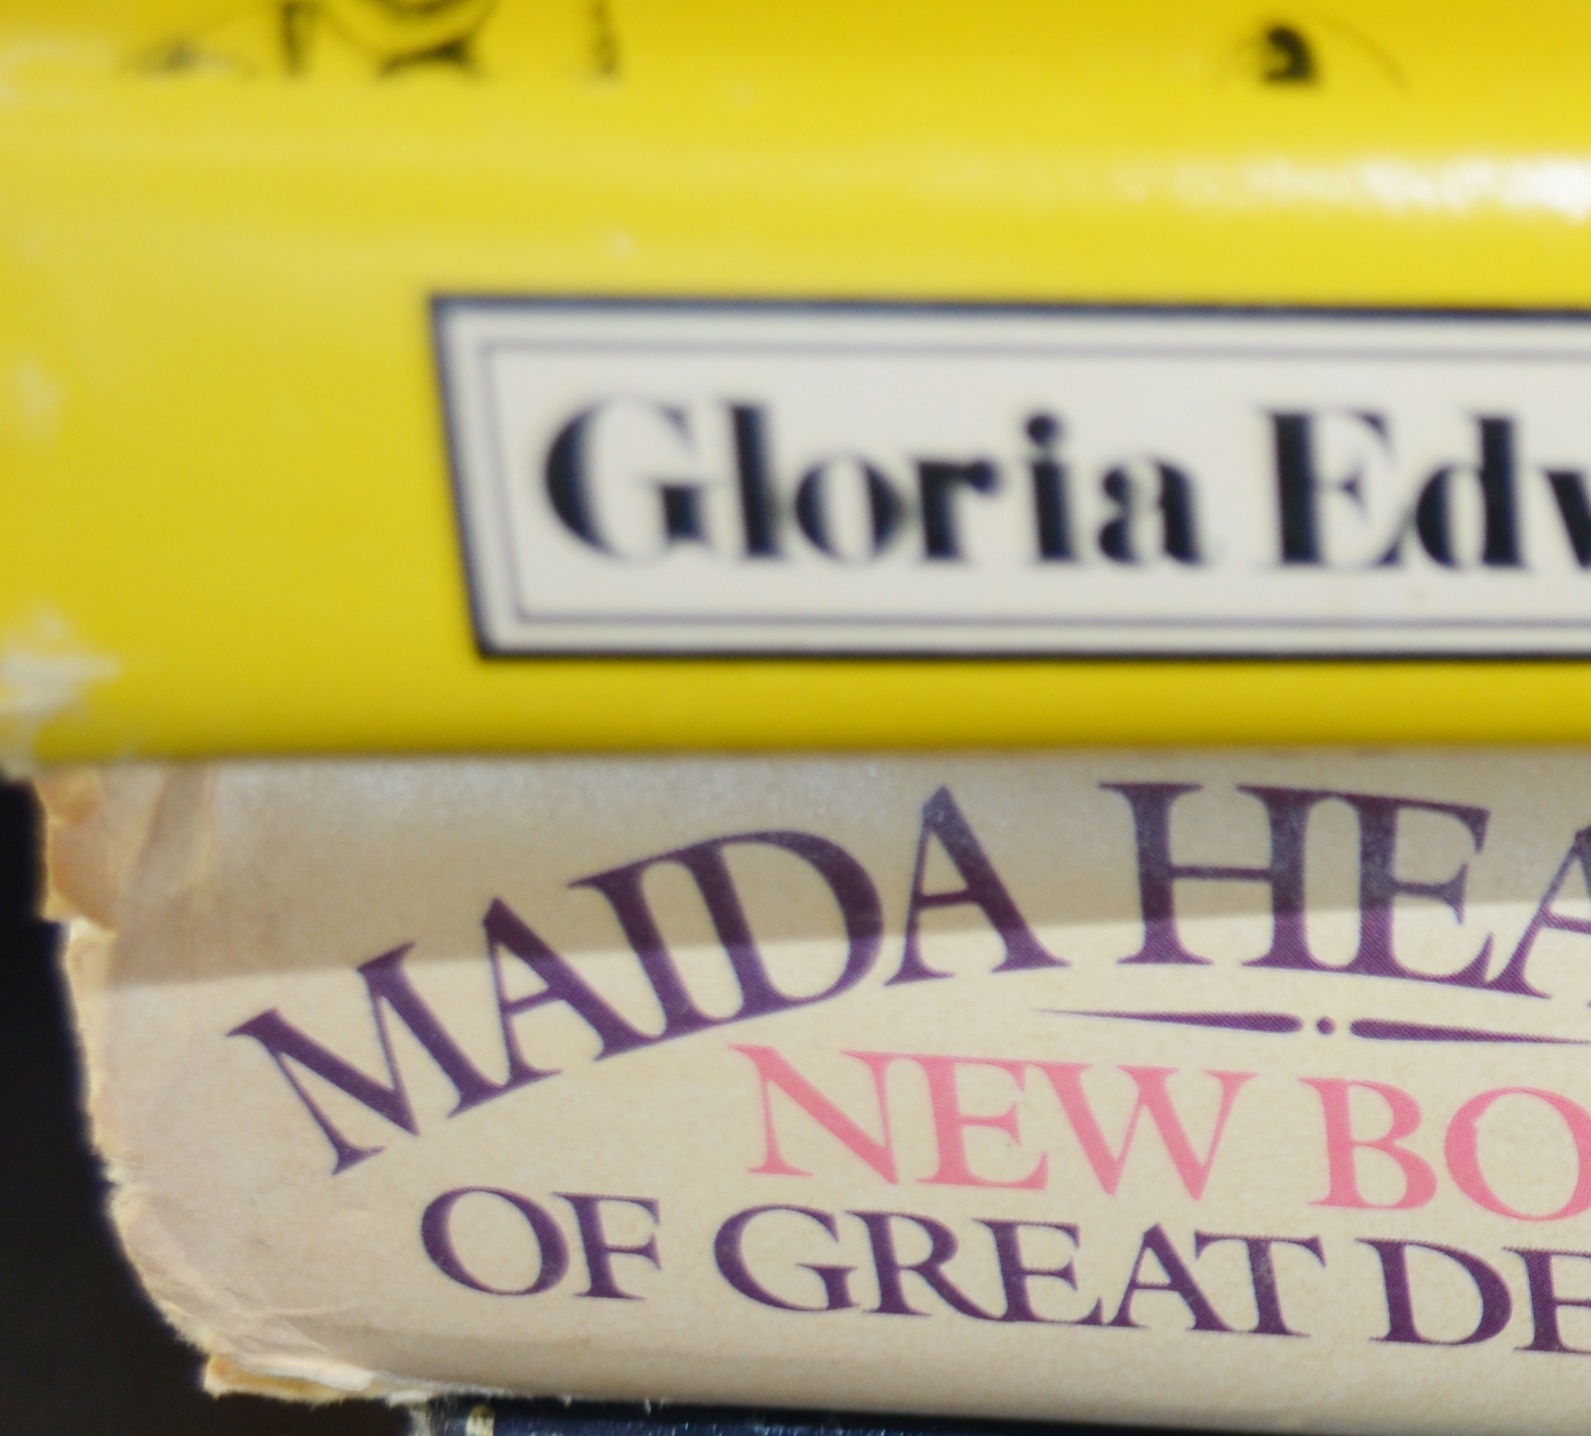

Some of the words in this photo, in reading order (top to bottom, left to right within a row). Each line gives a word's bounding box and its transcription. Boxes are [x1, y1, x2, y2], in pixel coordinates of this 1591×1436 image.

[540, 393, 1221, 567] Gloria
[225, 783, 1067, 1177] MAIDA
[727, 1043, 1256, 1201] NEW
[420, 1186, 661, 1301] OF
[713, 1205, 1327, 1339] GREAT
